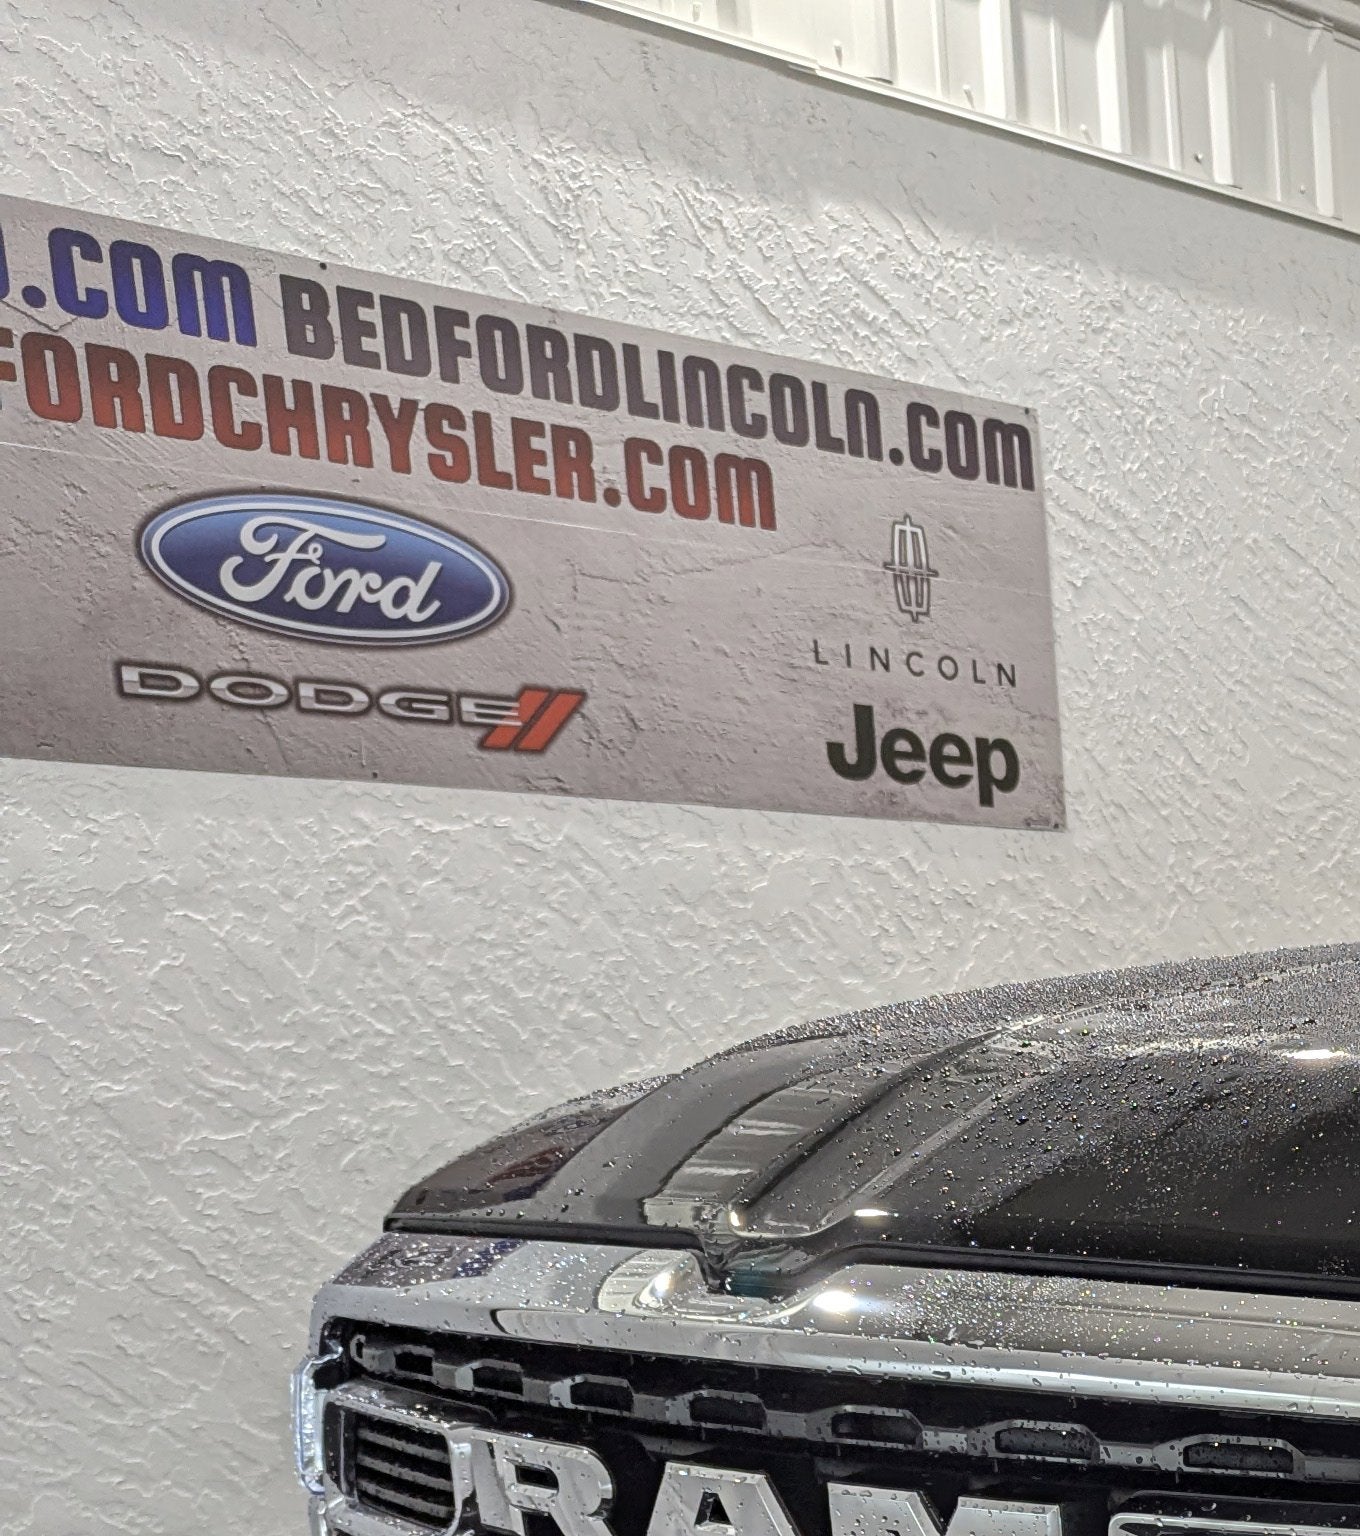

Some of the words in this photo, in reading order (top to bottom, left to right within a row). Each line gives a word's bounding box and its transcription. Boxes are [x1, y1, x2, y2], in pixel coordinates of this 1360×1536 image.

[0, 223, 257, 347] .COM
[280, 274, 1035, 491] BEDFORDLINCOLN.COM
[219, 514, 442, 624] Ford
[118, 661, 522, 726] DODGE
[812, 638, 1018, 689] LINCOLN
[826, 704, 1021, 807] Jeep
